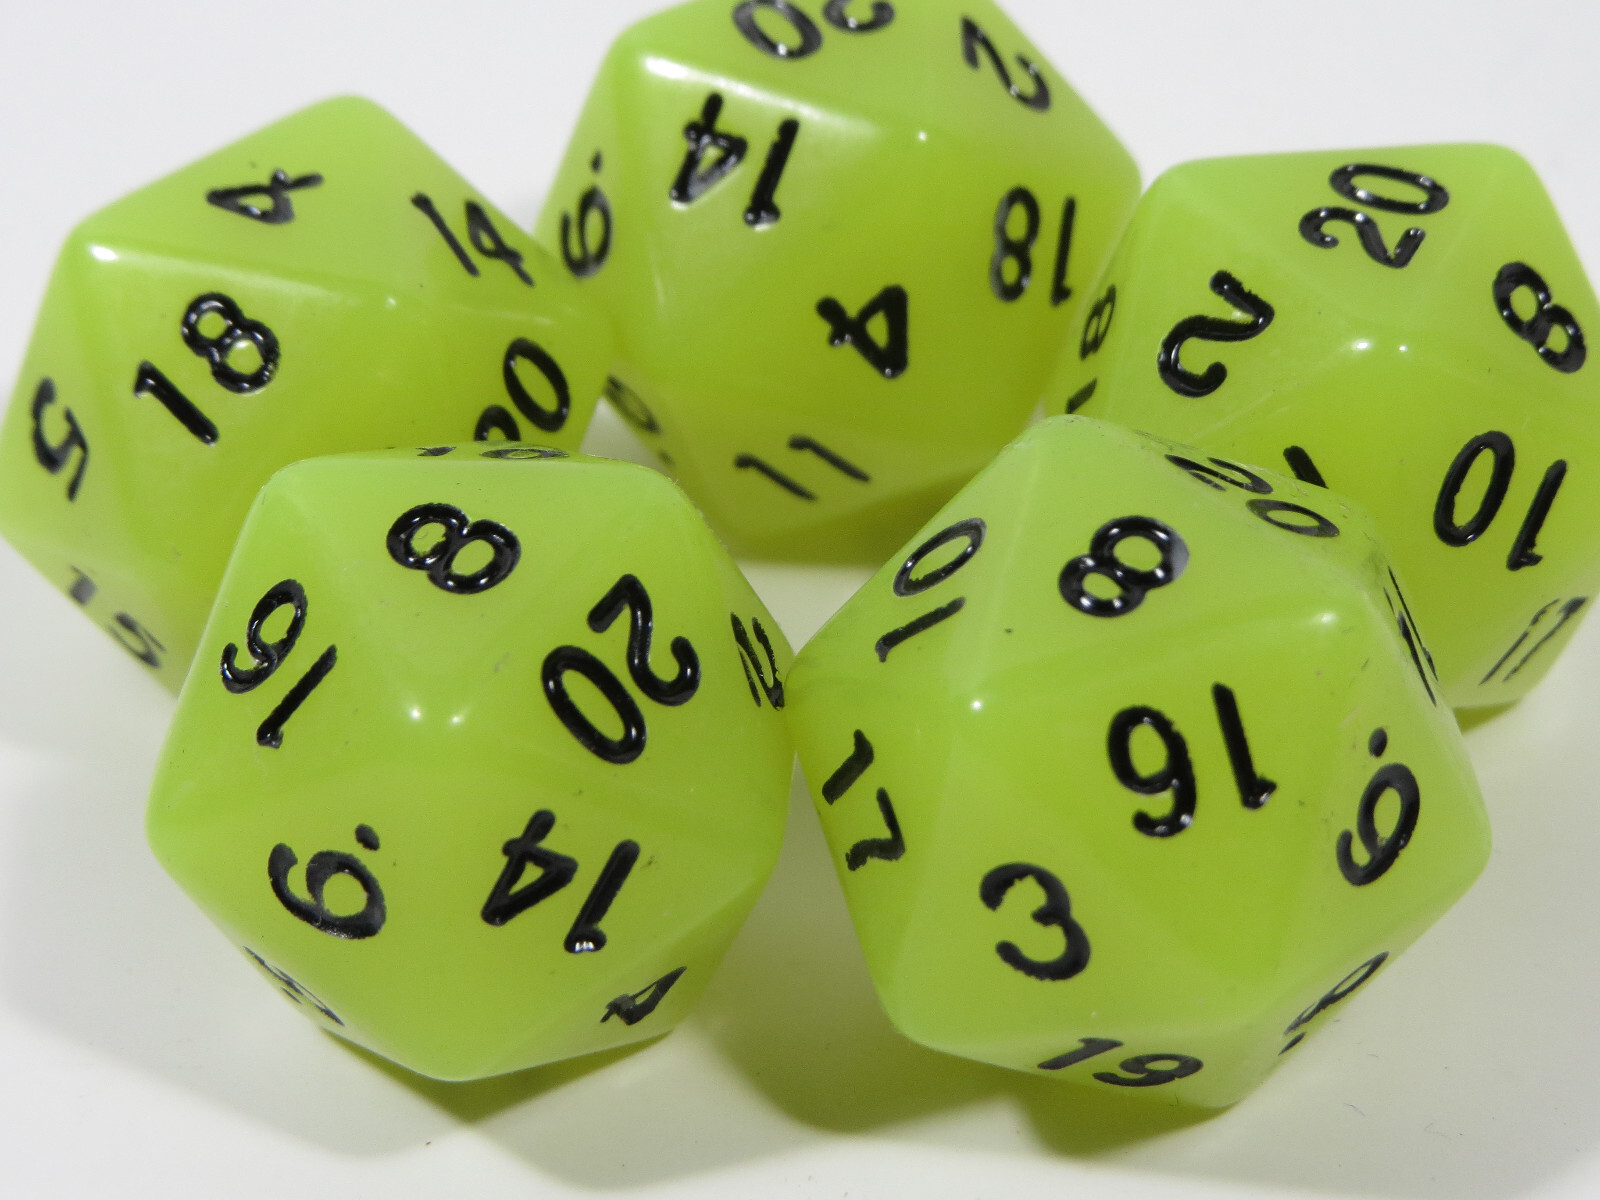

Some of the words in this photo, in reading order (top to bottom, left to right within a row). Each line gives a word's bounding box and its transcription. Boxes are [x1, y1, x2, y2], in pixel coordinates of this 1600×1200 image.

[960, 16, 1050, 111] 2
[206, 171, 323, 226] 4
[670, 92, 801, 228] 14
[1299, 162, 1449, 270] 20
[410, 192, 535, 287] 14
[989, 185, 1078, 307] 18
[134, 291, 281, 445] 18
[814, 283, 910, 380] 4
[1156, 269, 1276, 399] 2
[1492, 260, 1588, 375] 8
[31, 378, 91, 501] 5
[385, 501, 522, 595] 8
[1433, 429, 1568, 573] 10
[874, 517, 988, 664] 10
[1057, 514, 1190, 619] 8
[220, 577, 338, 749] 16
[539, 572, 701, 766] 20
[820, 729, 906, 872] 17
[1105, 682, 1278, 840] 16
[479, 808, 642, 956] 14
[978, 861, 1092, 983] 3
[1035, 1036, 1205, 1088] 19
